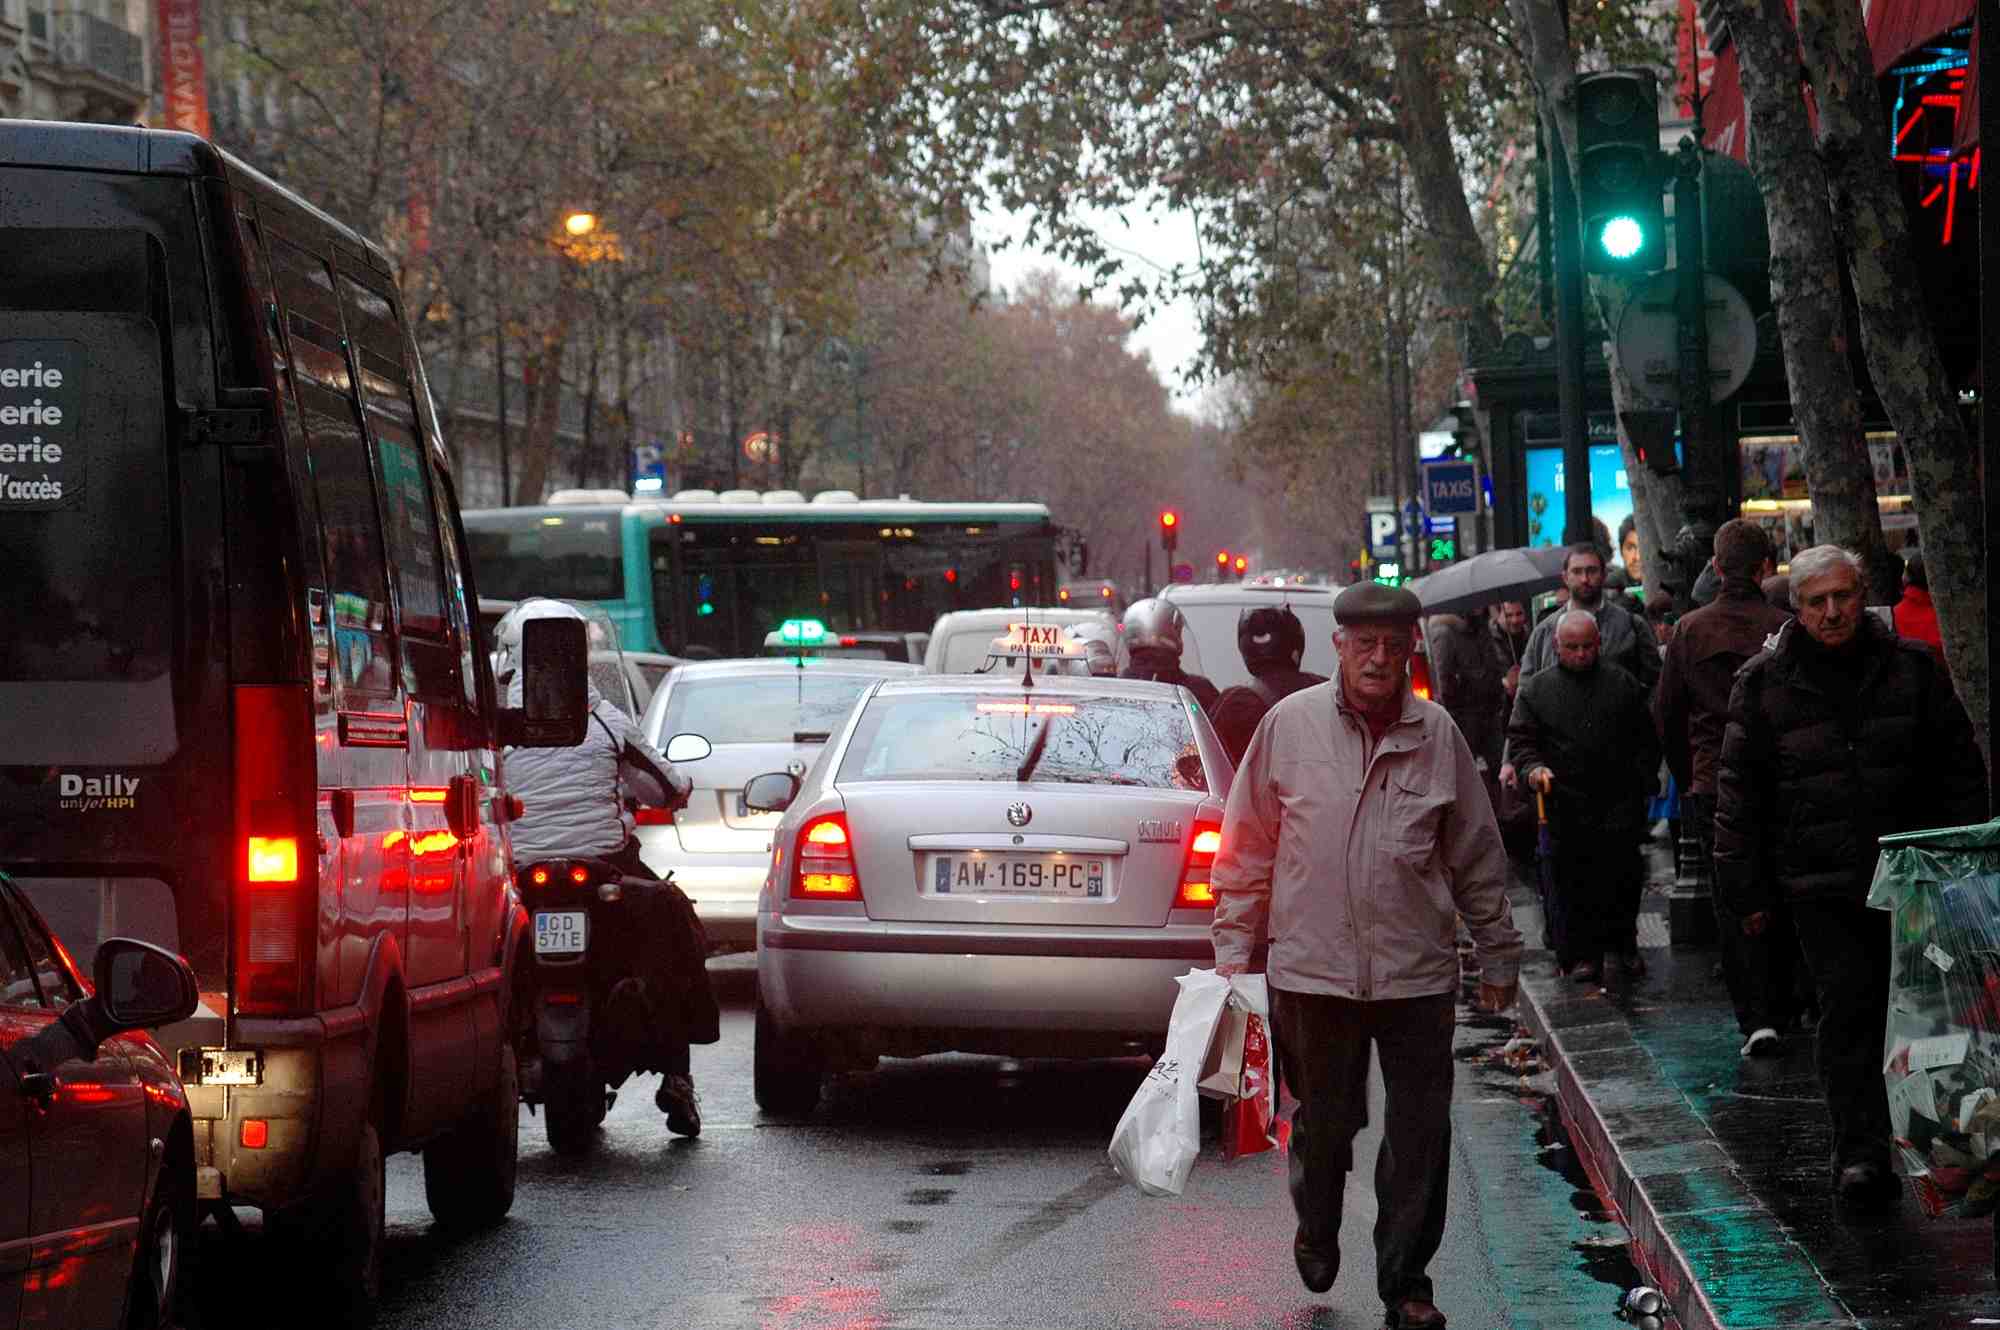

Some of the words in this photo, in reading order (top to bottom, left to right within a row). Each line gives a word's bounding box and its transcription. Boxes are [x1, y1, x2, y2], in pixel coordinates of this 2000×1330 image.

[0, 361, 63, 388] erie
[1432, 480, 1473, 498] TAXIS
[1371, 513, 1397, 546] P
[1019, 626, 1059, 645] TAXI
[60, 774, 140, 797] Daily
[957, 861, 1084, 889] AW-169-PC
[1088, 878, 1102, 893] 91
[539, 932, 581, 947] 571E
